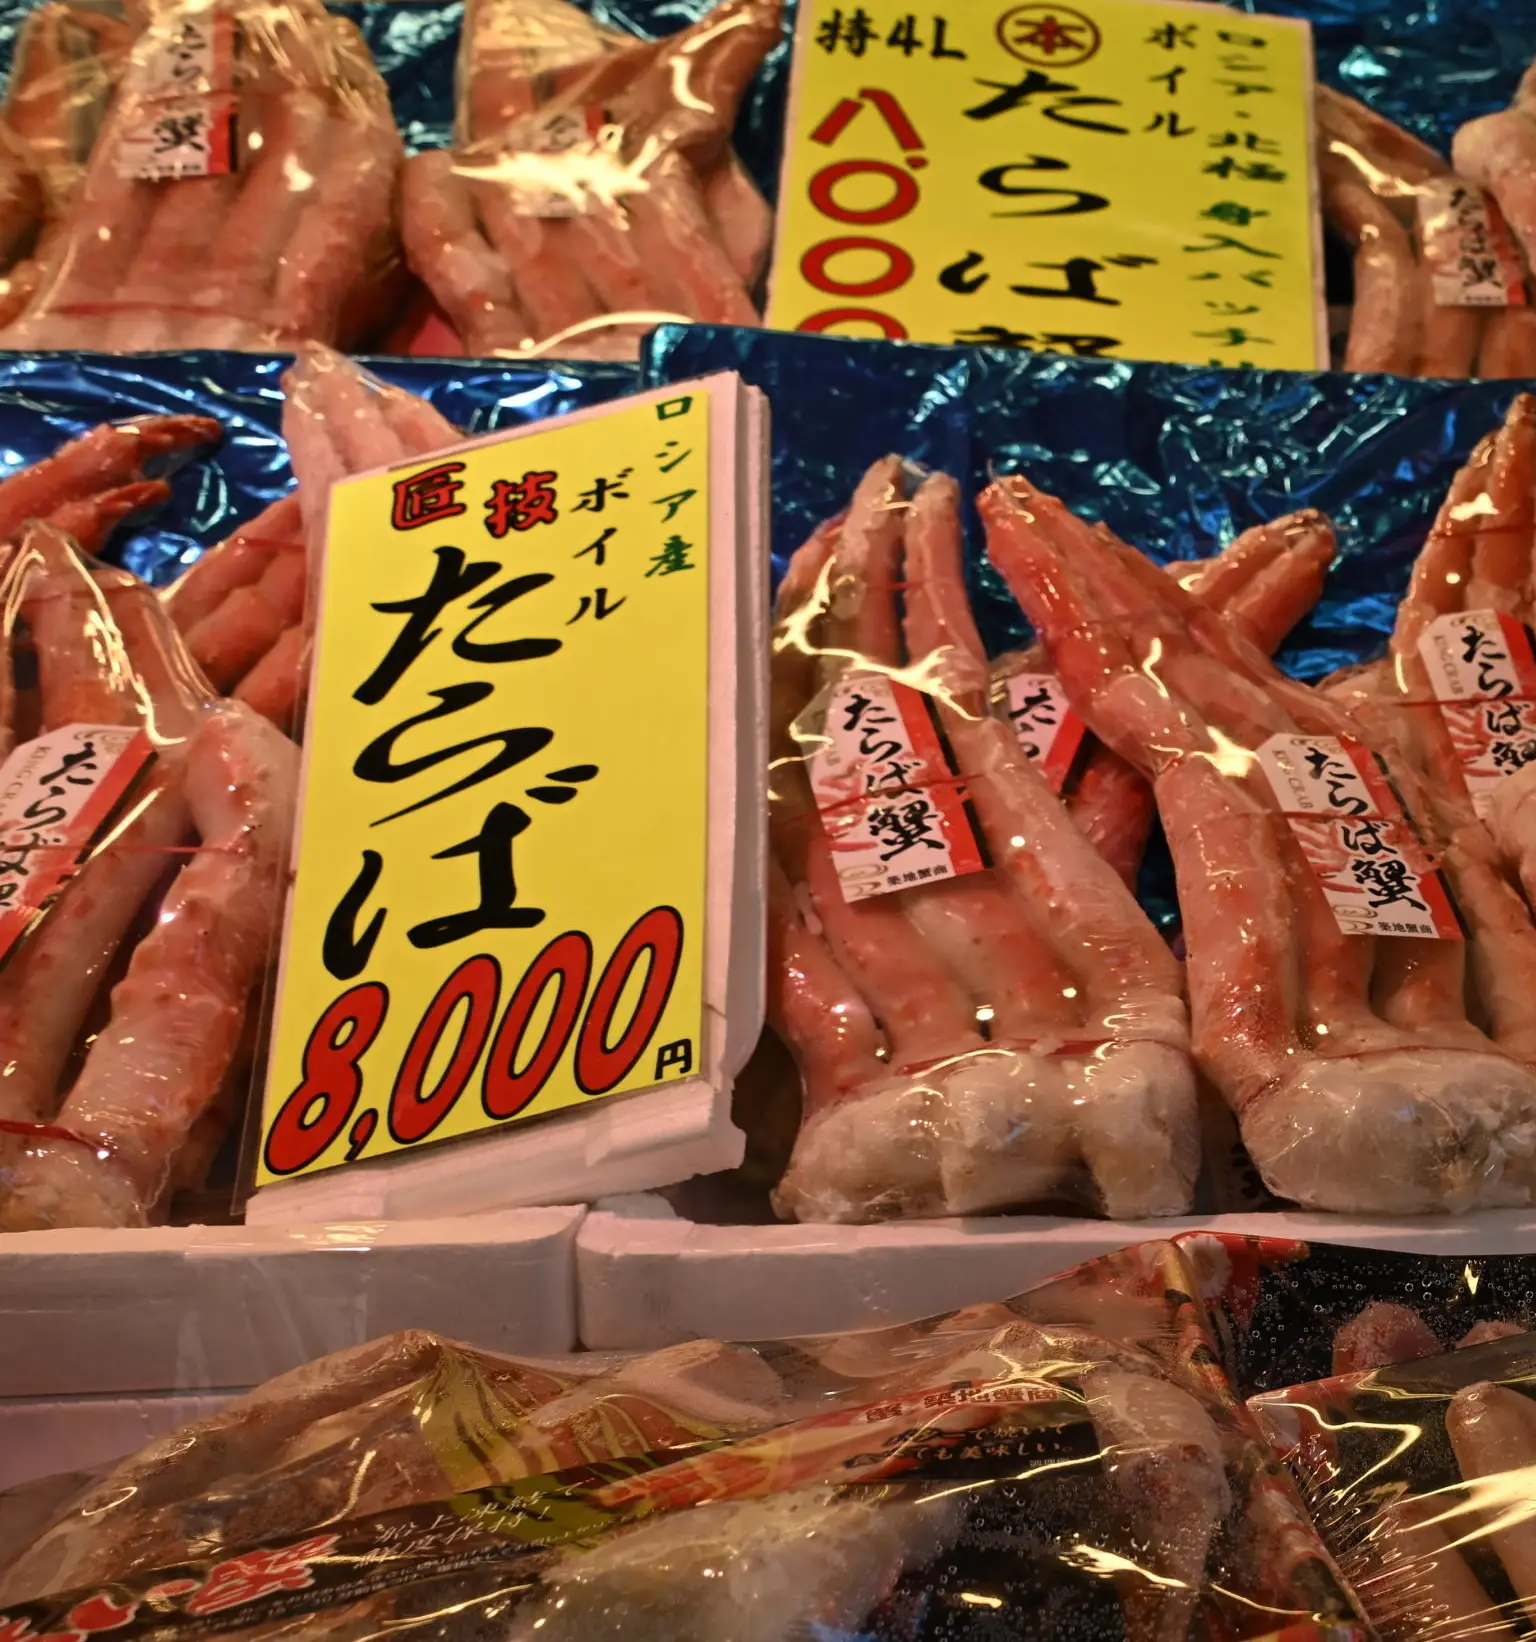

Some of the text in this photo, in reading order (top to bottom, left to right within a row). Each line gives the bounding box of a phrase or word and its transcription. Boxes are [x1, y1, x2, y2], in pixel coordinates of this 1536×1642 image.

[1144, 22, 1199, 140] ボイル
[391, 462, 559, 538] 匠技
[565, 466, 635, 627] ボイル
[644, 394, 696, 579] ロシア産
[322, 544, 601, 980] たらば
[842, 694, 946, 862] たらば蟹
[1304, 746, 1428, 912] たらば蟹
